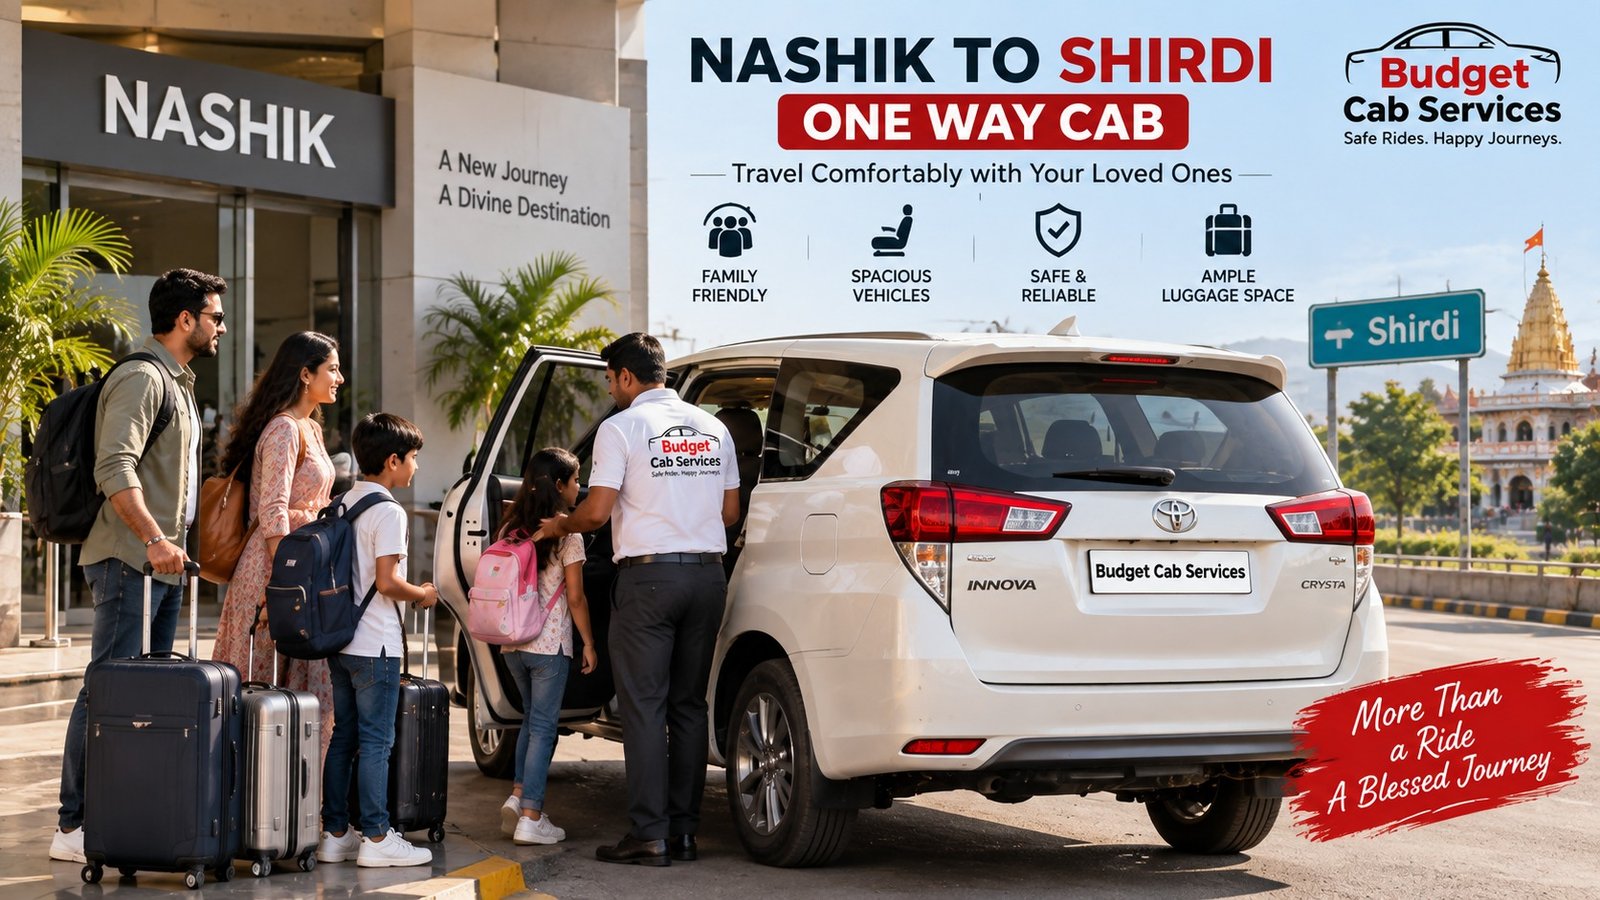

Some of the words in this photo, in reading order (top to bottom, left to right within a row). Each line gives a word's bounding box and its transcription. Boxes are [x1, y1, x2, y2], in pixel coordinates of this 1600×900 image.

[104, 74, 335, 168] NASHIK
[438, 149, 452, 172] A
[458, 152, 496, 178] New
[501, 161, 568, 195] Journey
[438, 184, 452, 206] A
[459, 187, 512, 214] Divine
[518, 195, 610, 229] Destination
[1368, 310, 1458, 345] Shirdi
[661, 439, 711, 455] Budget
[651, 457, 673, 468] Cab
[675, 455, 721, 467] Services
[1096, 563, 1150, 581] Budget
[1154, 564, 1181, 578] Cab
[1186, 564, 1245, 578] Services
[967, 579, 1037, 591] INNOVA
[1301, 580, 1346, 590] CRYSTA
